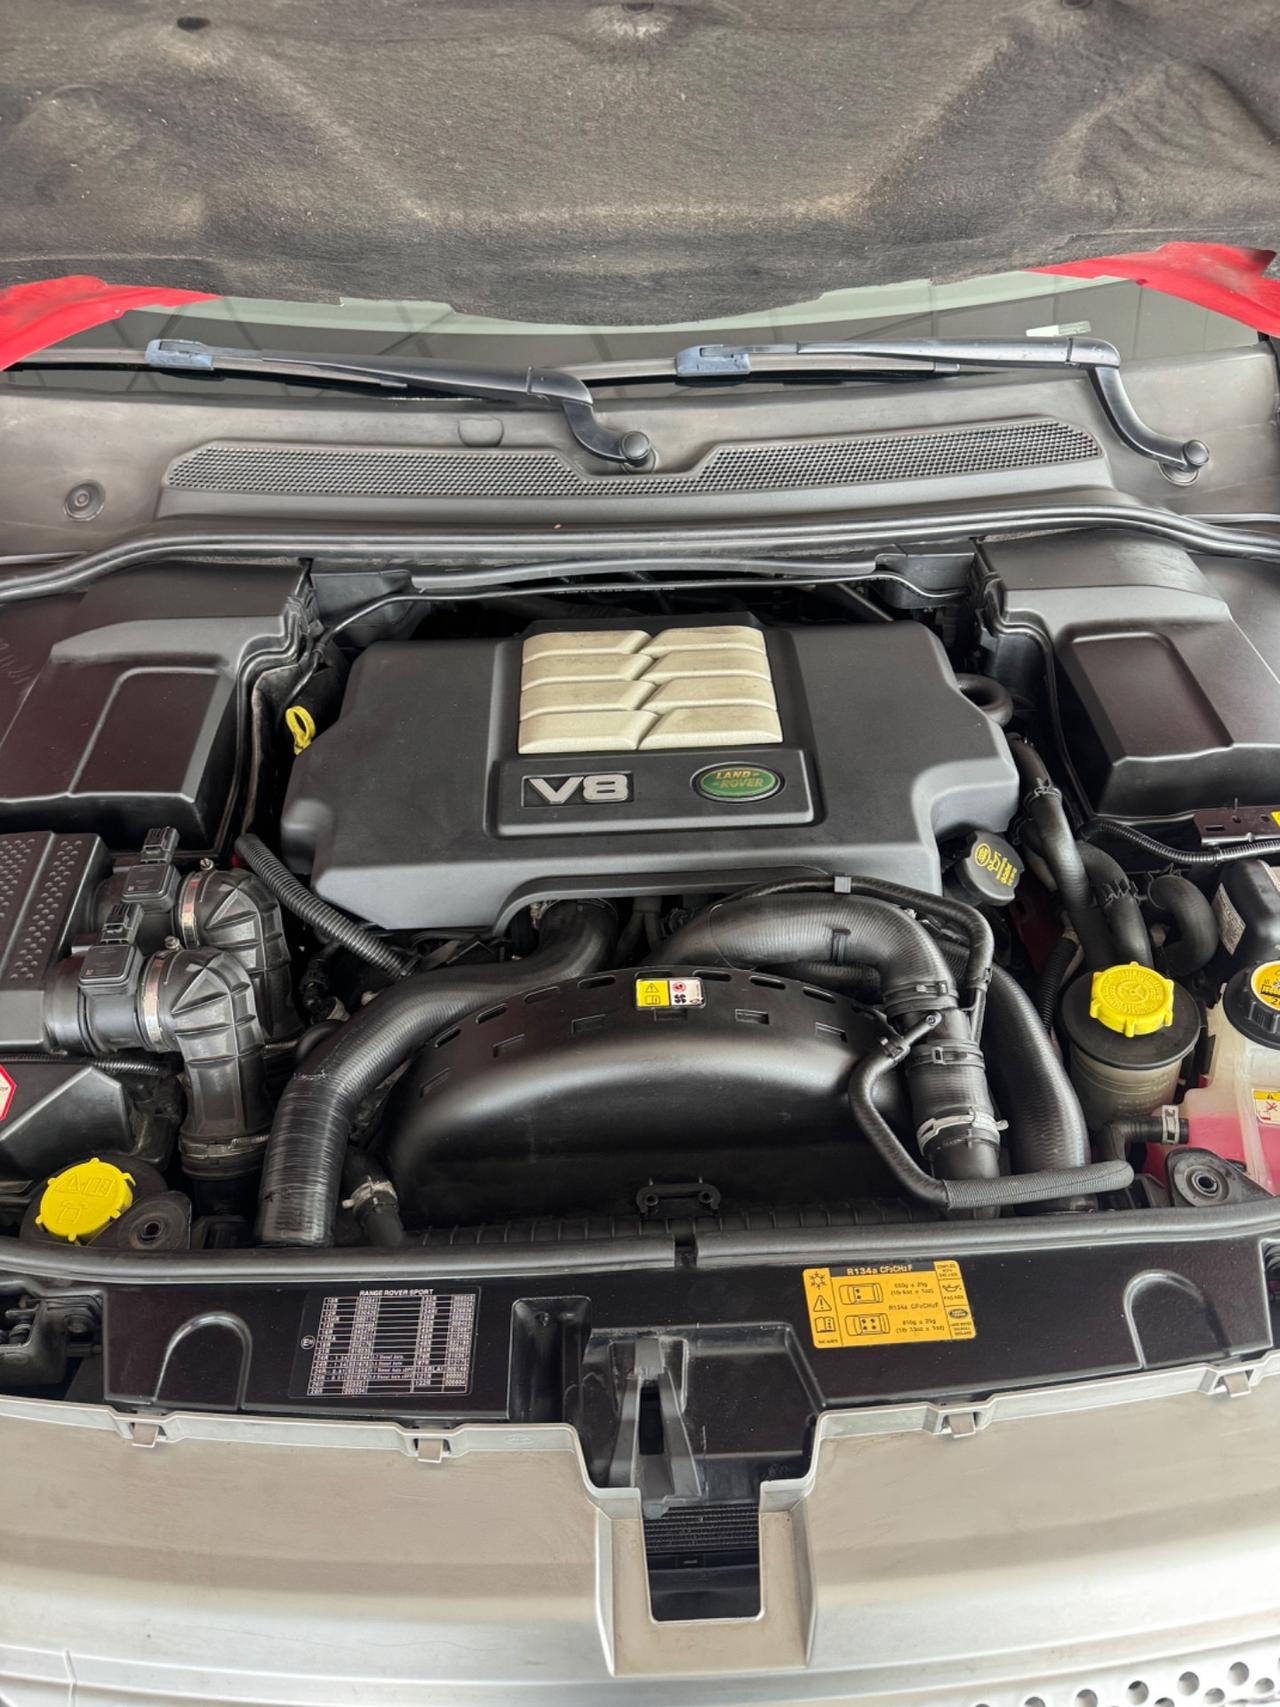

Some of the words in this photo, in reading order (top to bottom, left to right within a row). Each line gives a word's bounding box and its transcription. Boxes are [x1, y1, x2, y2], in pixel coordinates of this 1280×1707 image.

[714, 769, 752, 780] LAND
[719, 777, 764, 789] ROVER
[529, 774, 629, 805] V8
[847, 1266, 878, 1275] R134a
[359, 1289, 383, 1297] RANGE
[409, 1288, 434, 1296] SPORT
